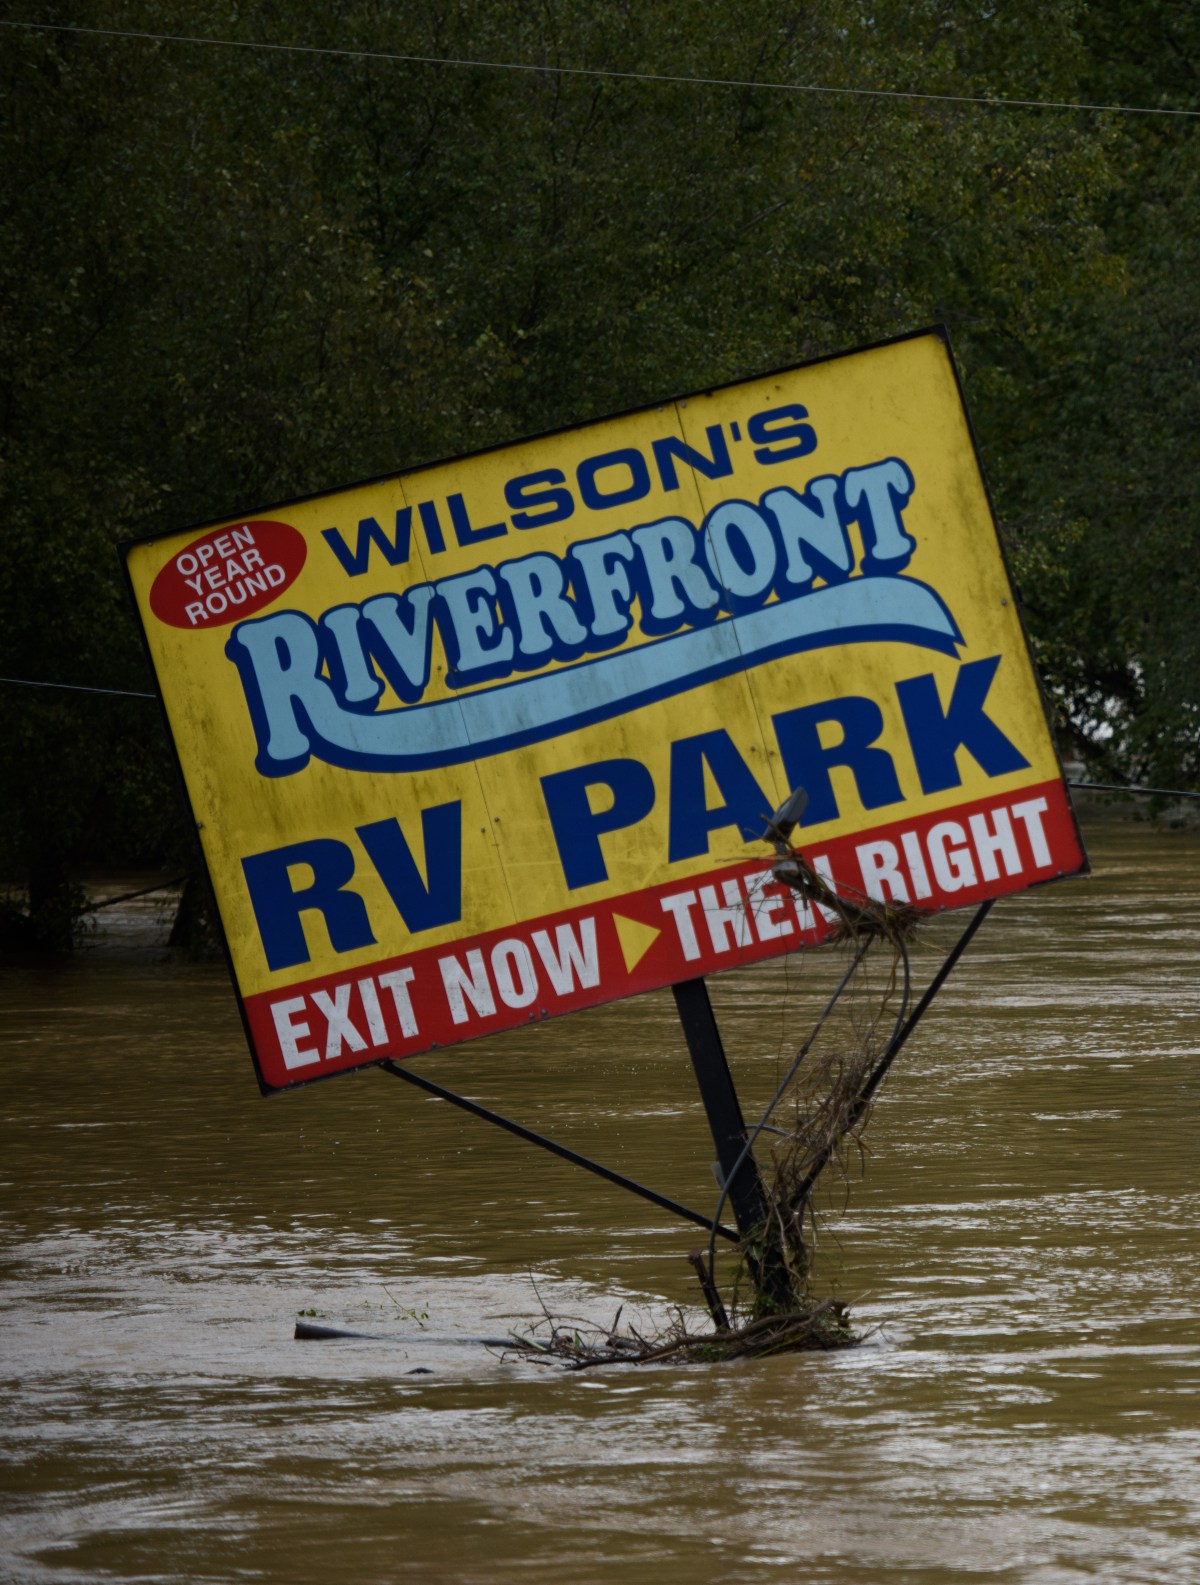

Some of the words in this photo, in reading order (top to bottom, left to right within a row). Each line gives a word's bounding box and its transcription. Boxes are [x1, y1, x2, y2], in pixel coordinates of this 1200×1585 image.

[176, 525, 256, 576] OPEN
[320, 403, 818, 577] WILSON'S
[184, 548, 266, 596] YEAR
[184, 564, 286, 625] ROUND
[225, 457, 916, 777] RIVERFRONT
[241, 800, 462, 972] RV
[540, 654, 1032, 891] PARK
[855, 797, 1048, 905] RIGHT
[270, 966, 419, 1070] EXIT
[437, 917, 601, 1025] NOW
